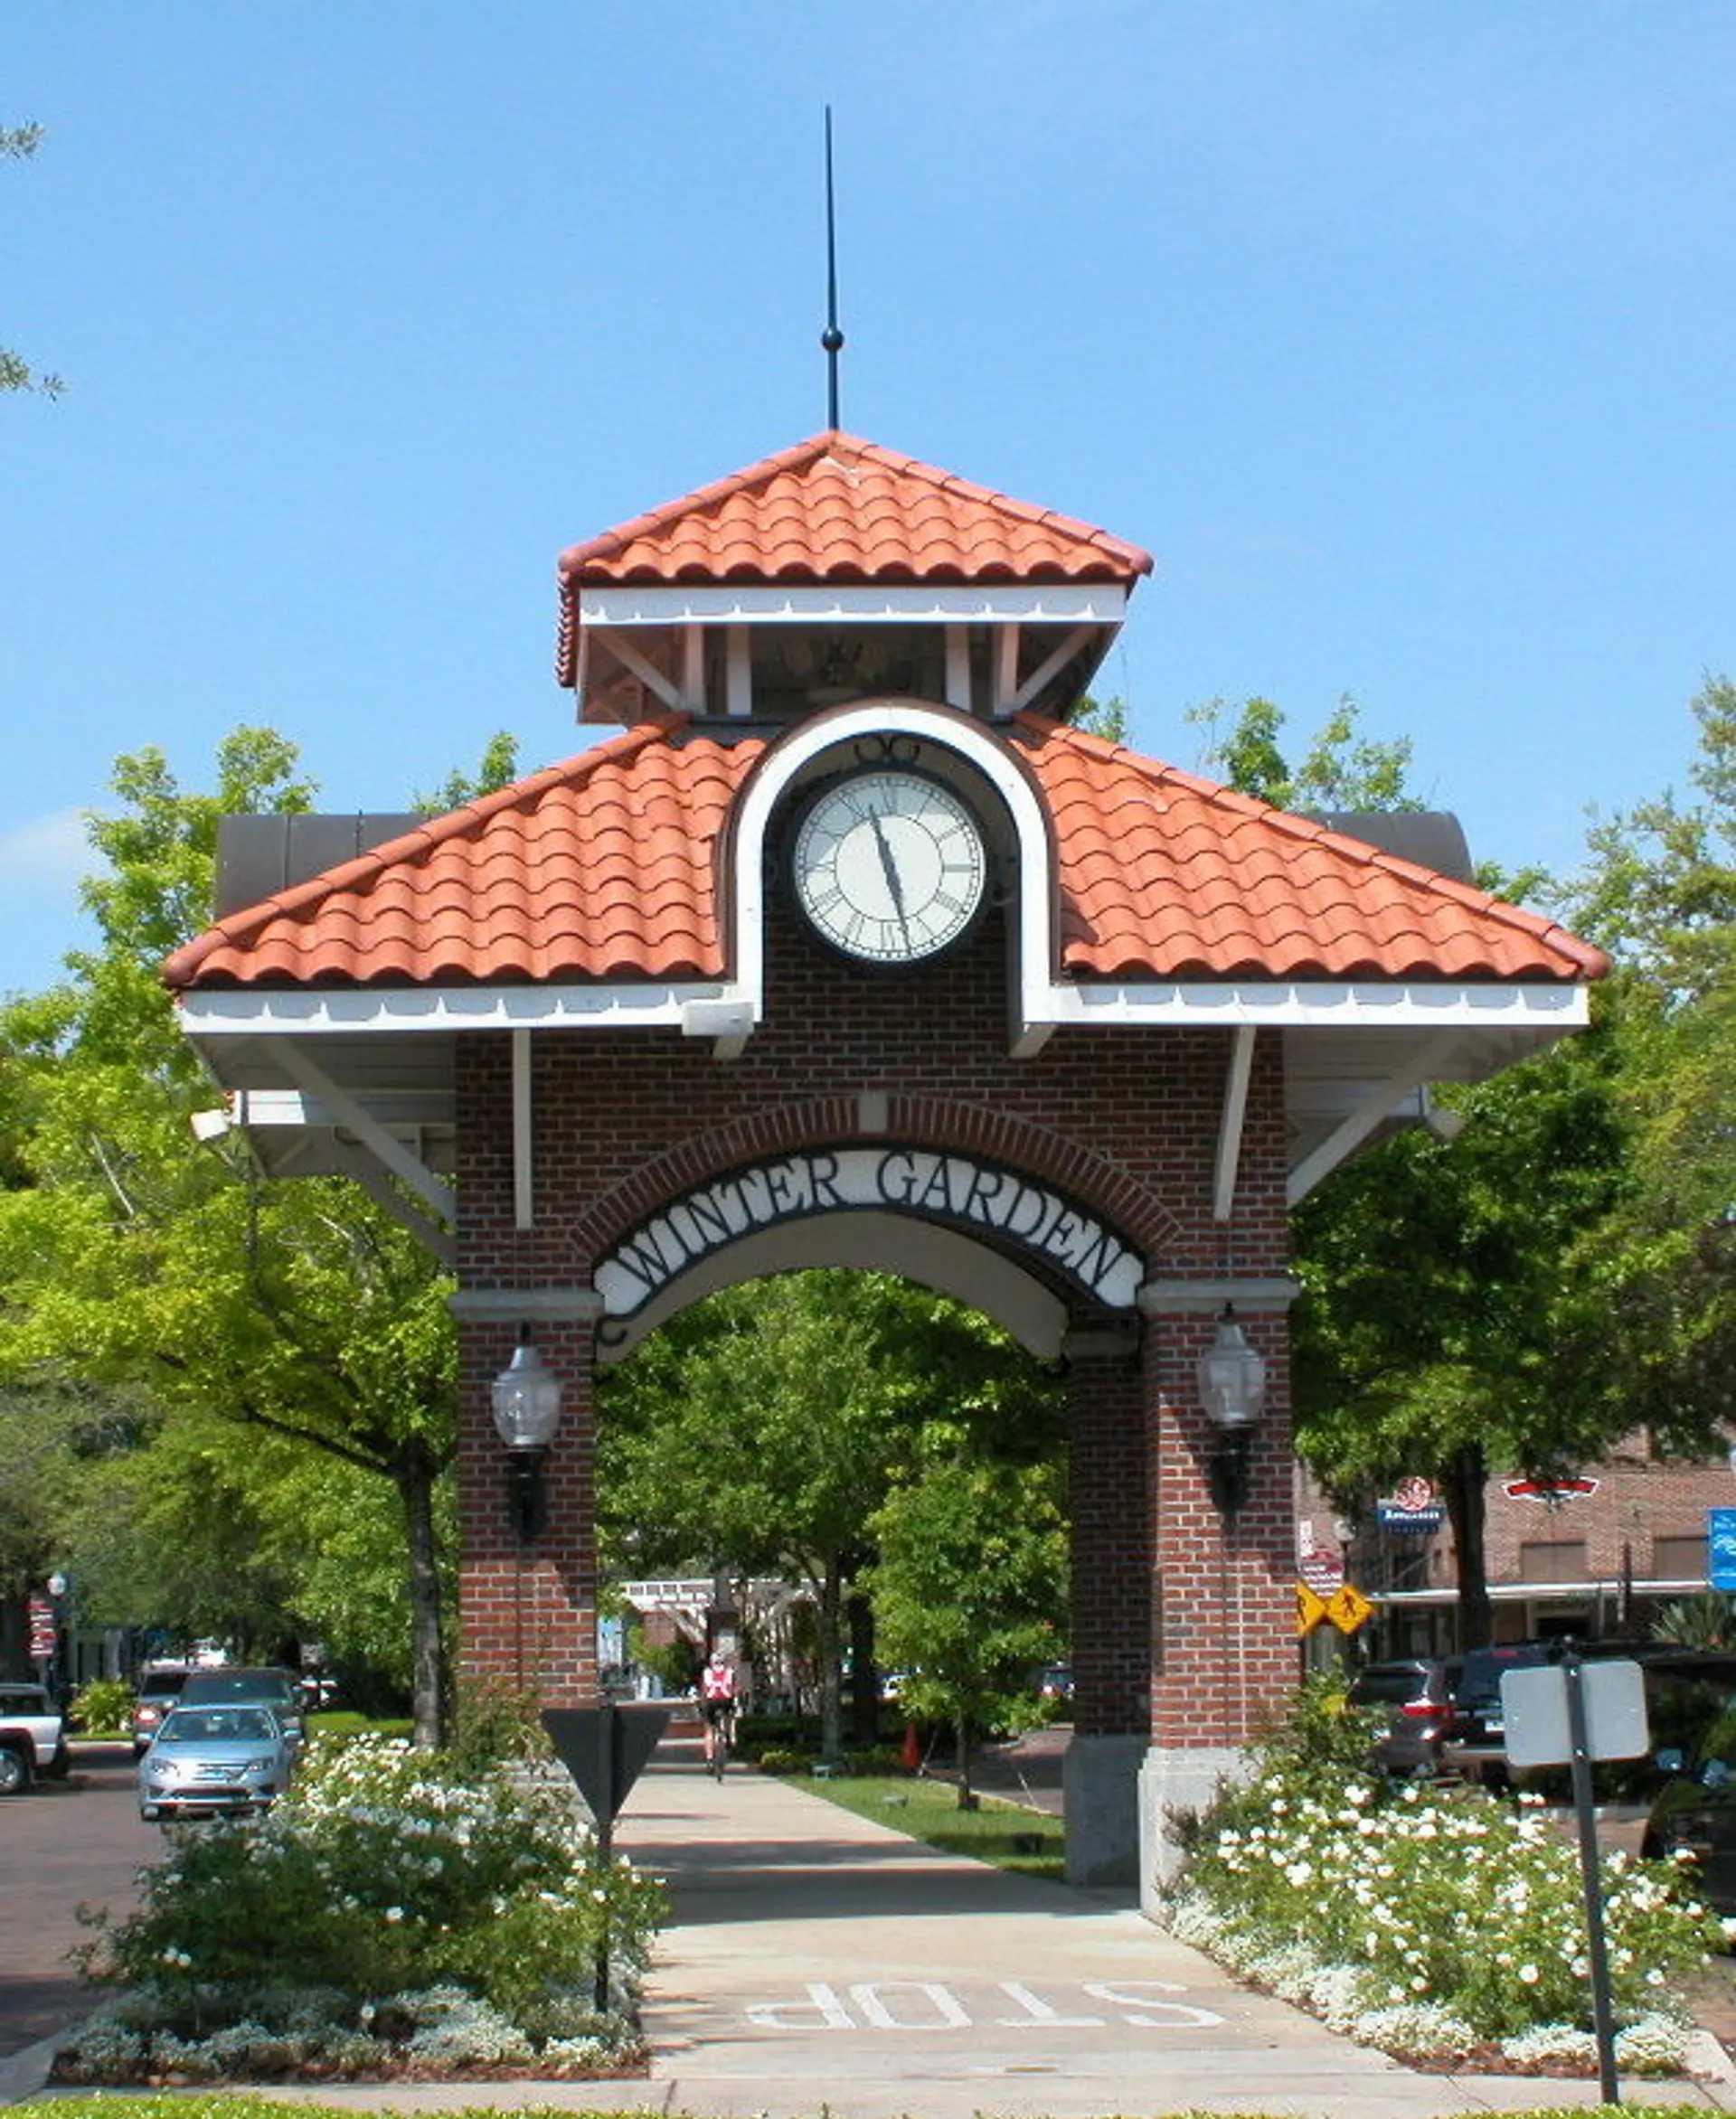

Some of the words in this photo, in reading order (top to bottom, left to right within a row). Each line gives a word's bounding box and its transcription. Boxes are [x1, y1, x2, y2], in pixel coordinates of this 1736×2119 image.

[612, 1152, 848, 1291] WINTER
[877, 1149, 1127, 1290] GARDEN
[745, 1981, 1226, 2030] STOP
